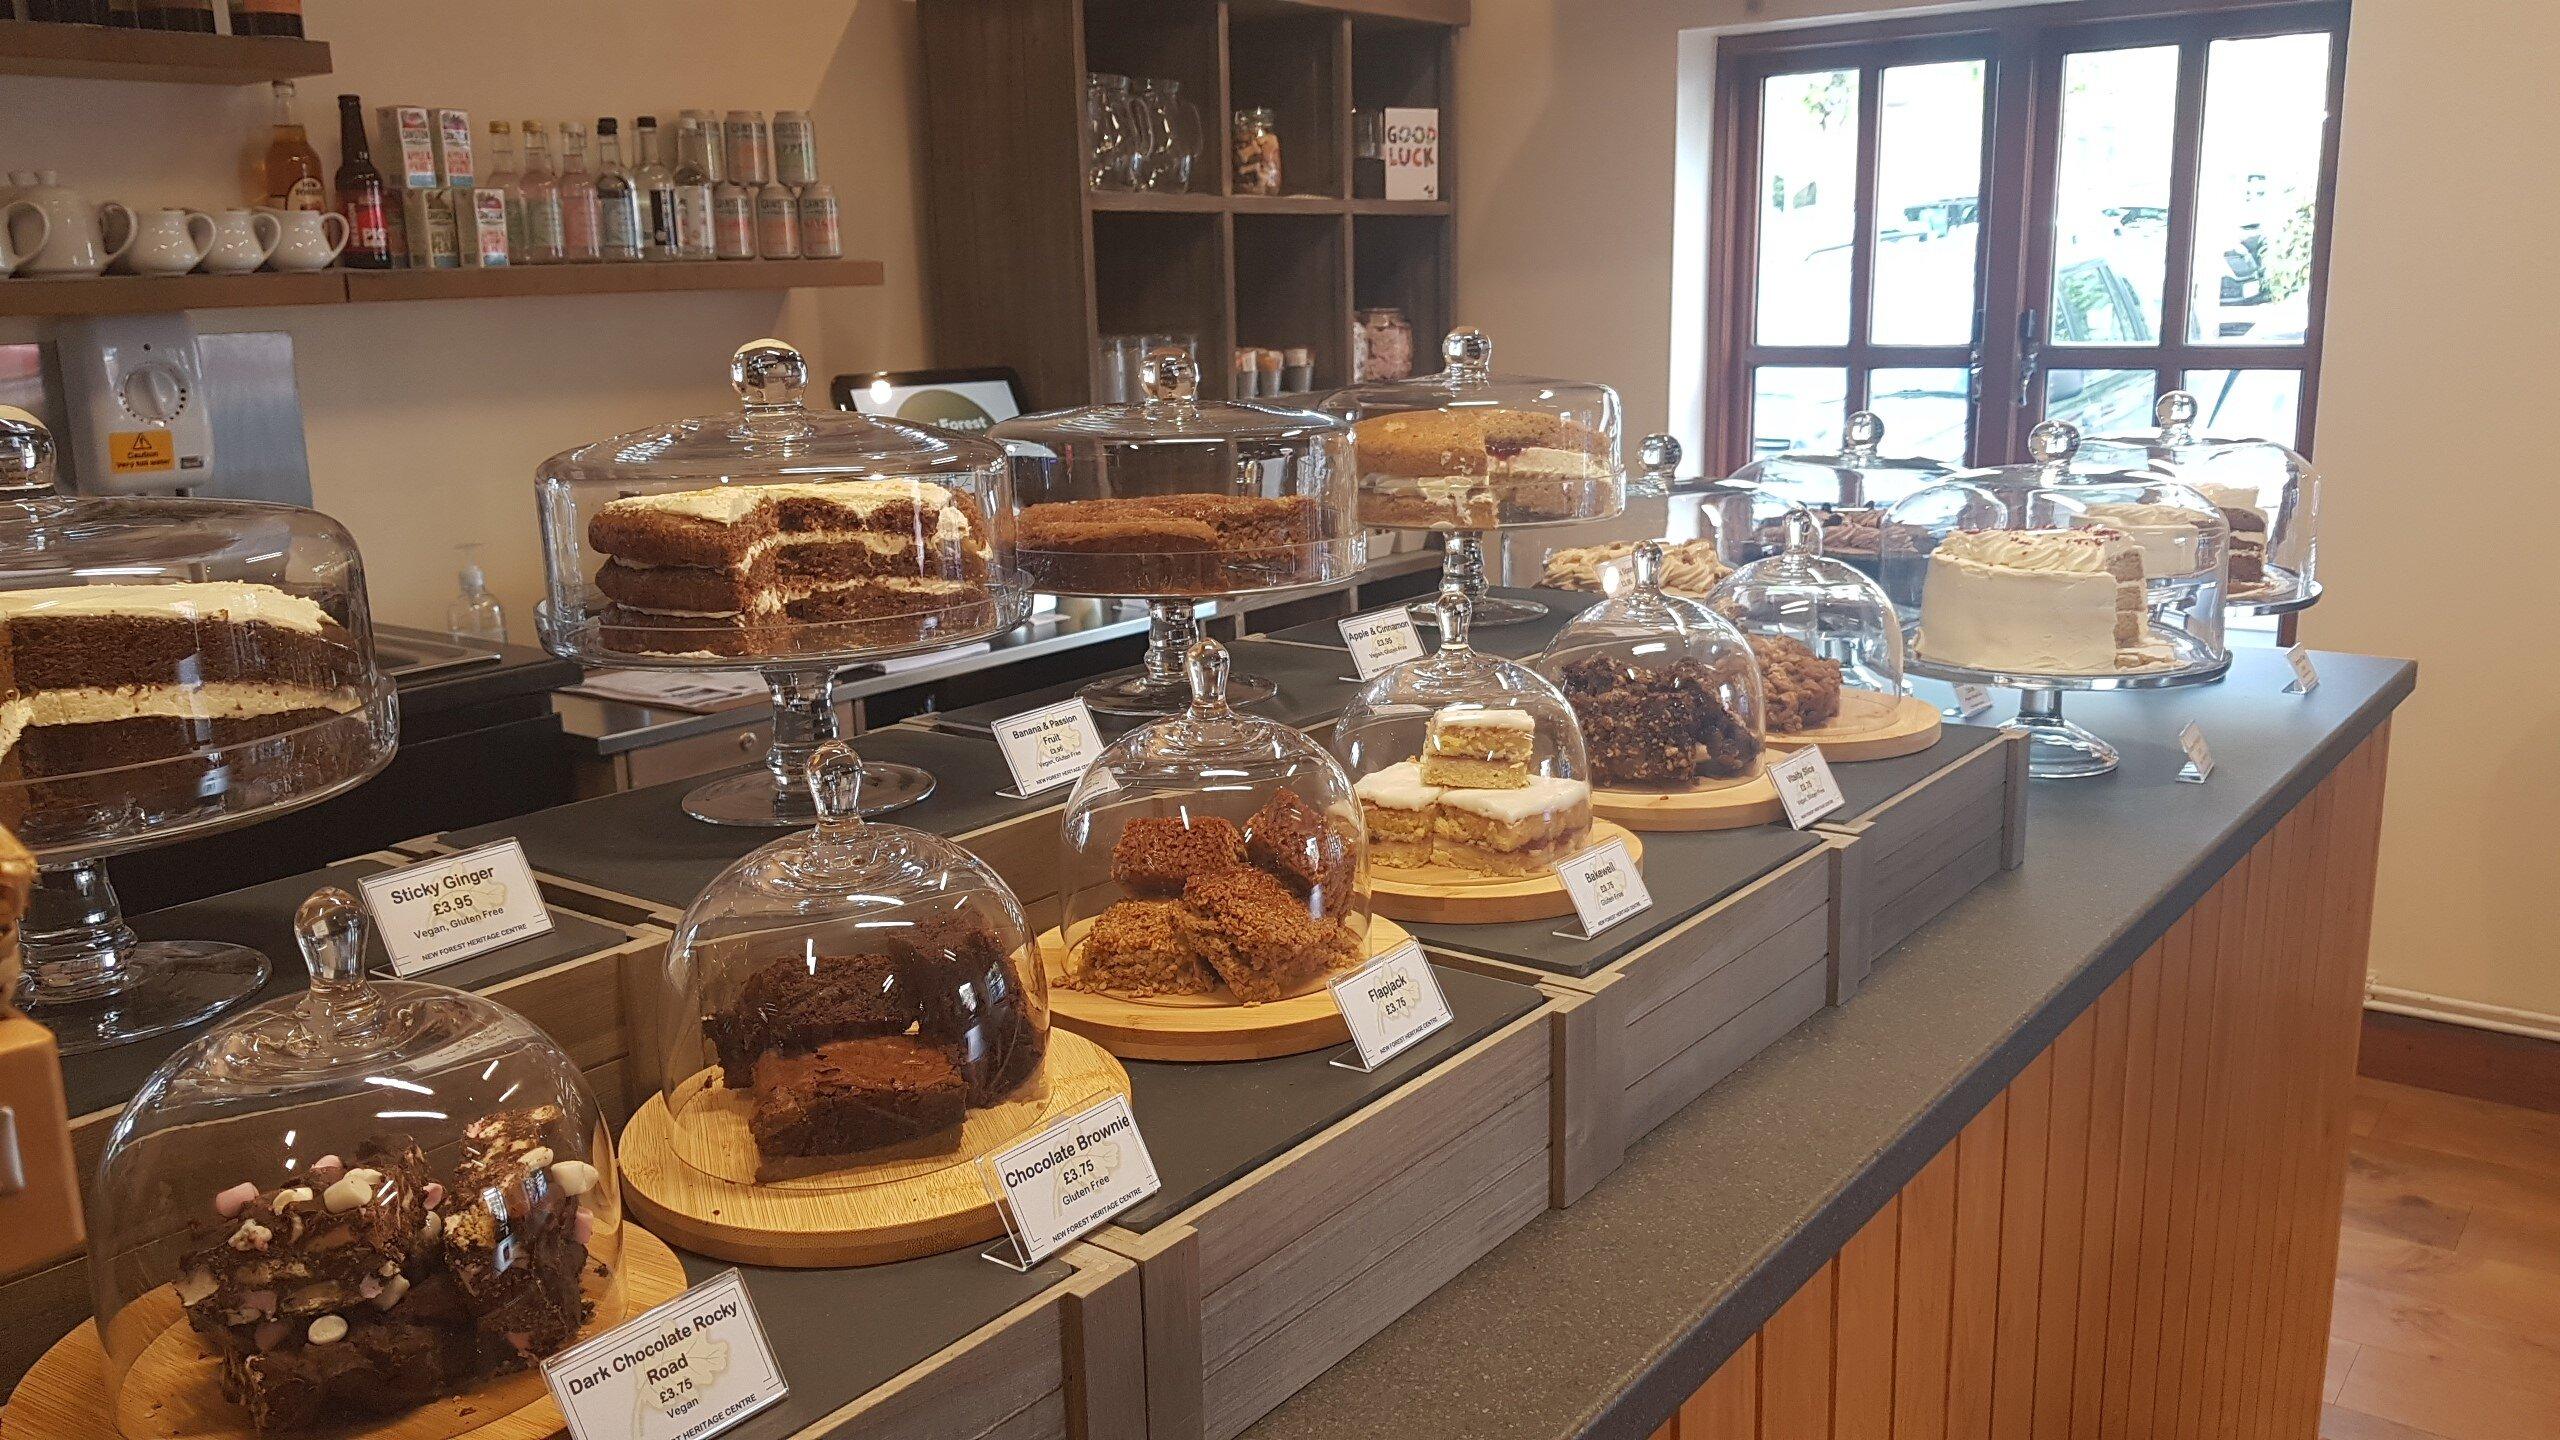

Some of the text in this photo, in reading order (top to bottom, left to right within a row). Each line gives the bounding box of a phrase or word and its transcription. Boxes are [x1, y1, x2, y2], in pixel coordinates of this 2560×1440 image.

[1388, 126, 1436, 143] GOOD
[1389, 147, 1434, 167] LUCK
[1348, 621, 1409, 641] Apple & Cinnamon
[1012, 715, 1077, 739] Banana & Passion
[1043, 734, 1061, 745] Fruit
[391, 866, 494, 905] Sticky Ginger
[1584, 862, 1616, 883] Bakewell
[433, 895, 473, 916] £3.95
[414, 906, 504, 940] Vegan, Gluten Free
[422, 923, 528, 961] NEW FOREST HERITAGE CENTRE
[1368, 974, 1407, 1002] Flapjack
[1385, 997, 1407, 1015] £3.75
[1005, 1114, 1130, 1189] Chocolate Brownie
[1063, 1160, 1094, 1185] £3.75
[1062, 1176, 1110, 1206] Gluten Free
[1052, 1187, 1143, 1243] NEW FOREST HERITAGE CENTRE
[569, 1301, 738, 1396] Dark Chocolate Rocky
[646, 1354, 689, 1386] Road
[660, 1378, 692, 1404] £3.75
[666, 1397, 699, 1418] Vegan
[683, 1394, 757, 1440] HERITAGE CENTRE
